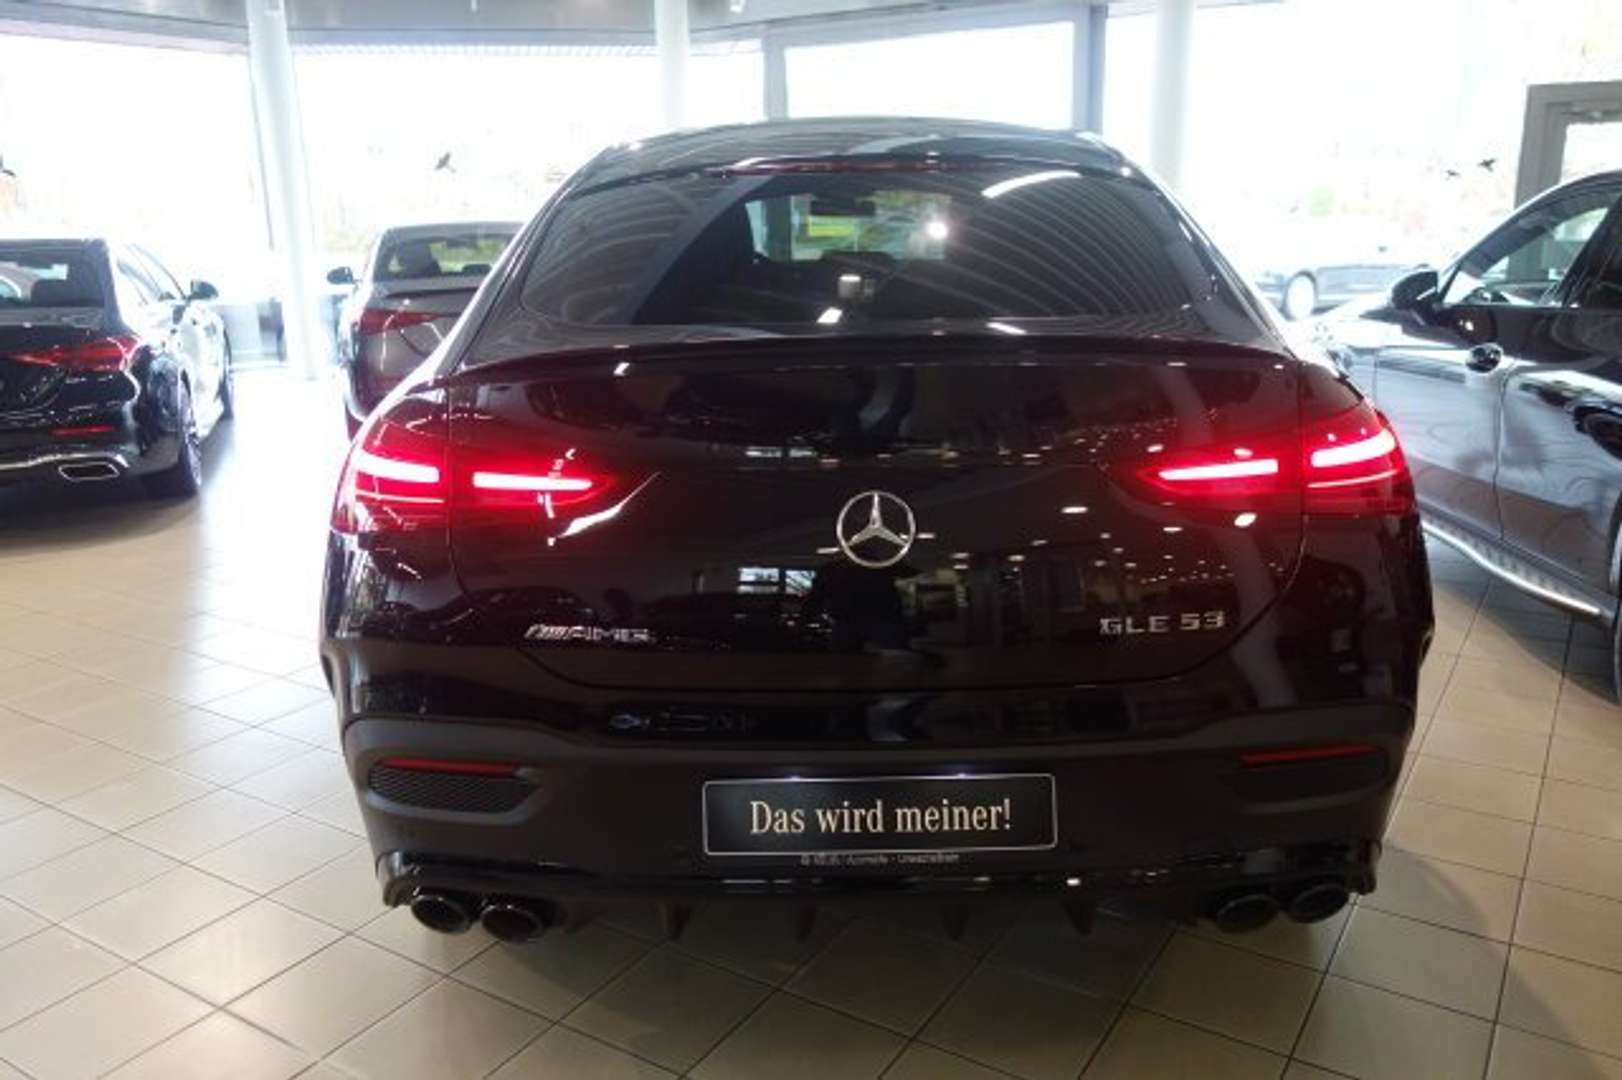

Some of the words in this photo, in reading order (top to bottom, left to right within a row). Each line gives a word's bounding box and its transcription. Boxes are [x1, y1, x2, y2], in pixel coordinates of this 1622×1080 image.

[1099, 615, 1169, 634] GLE
[1180, 610, 1225, 630] 53
[750, 800, 805, 833] Das
[815, 799, 885, 833] wird
[894, 798, 1011, 831] meiner!
